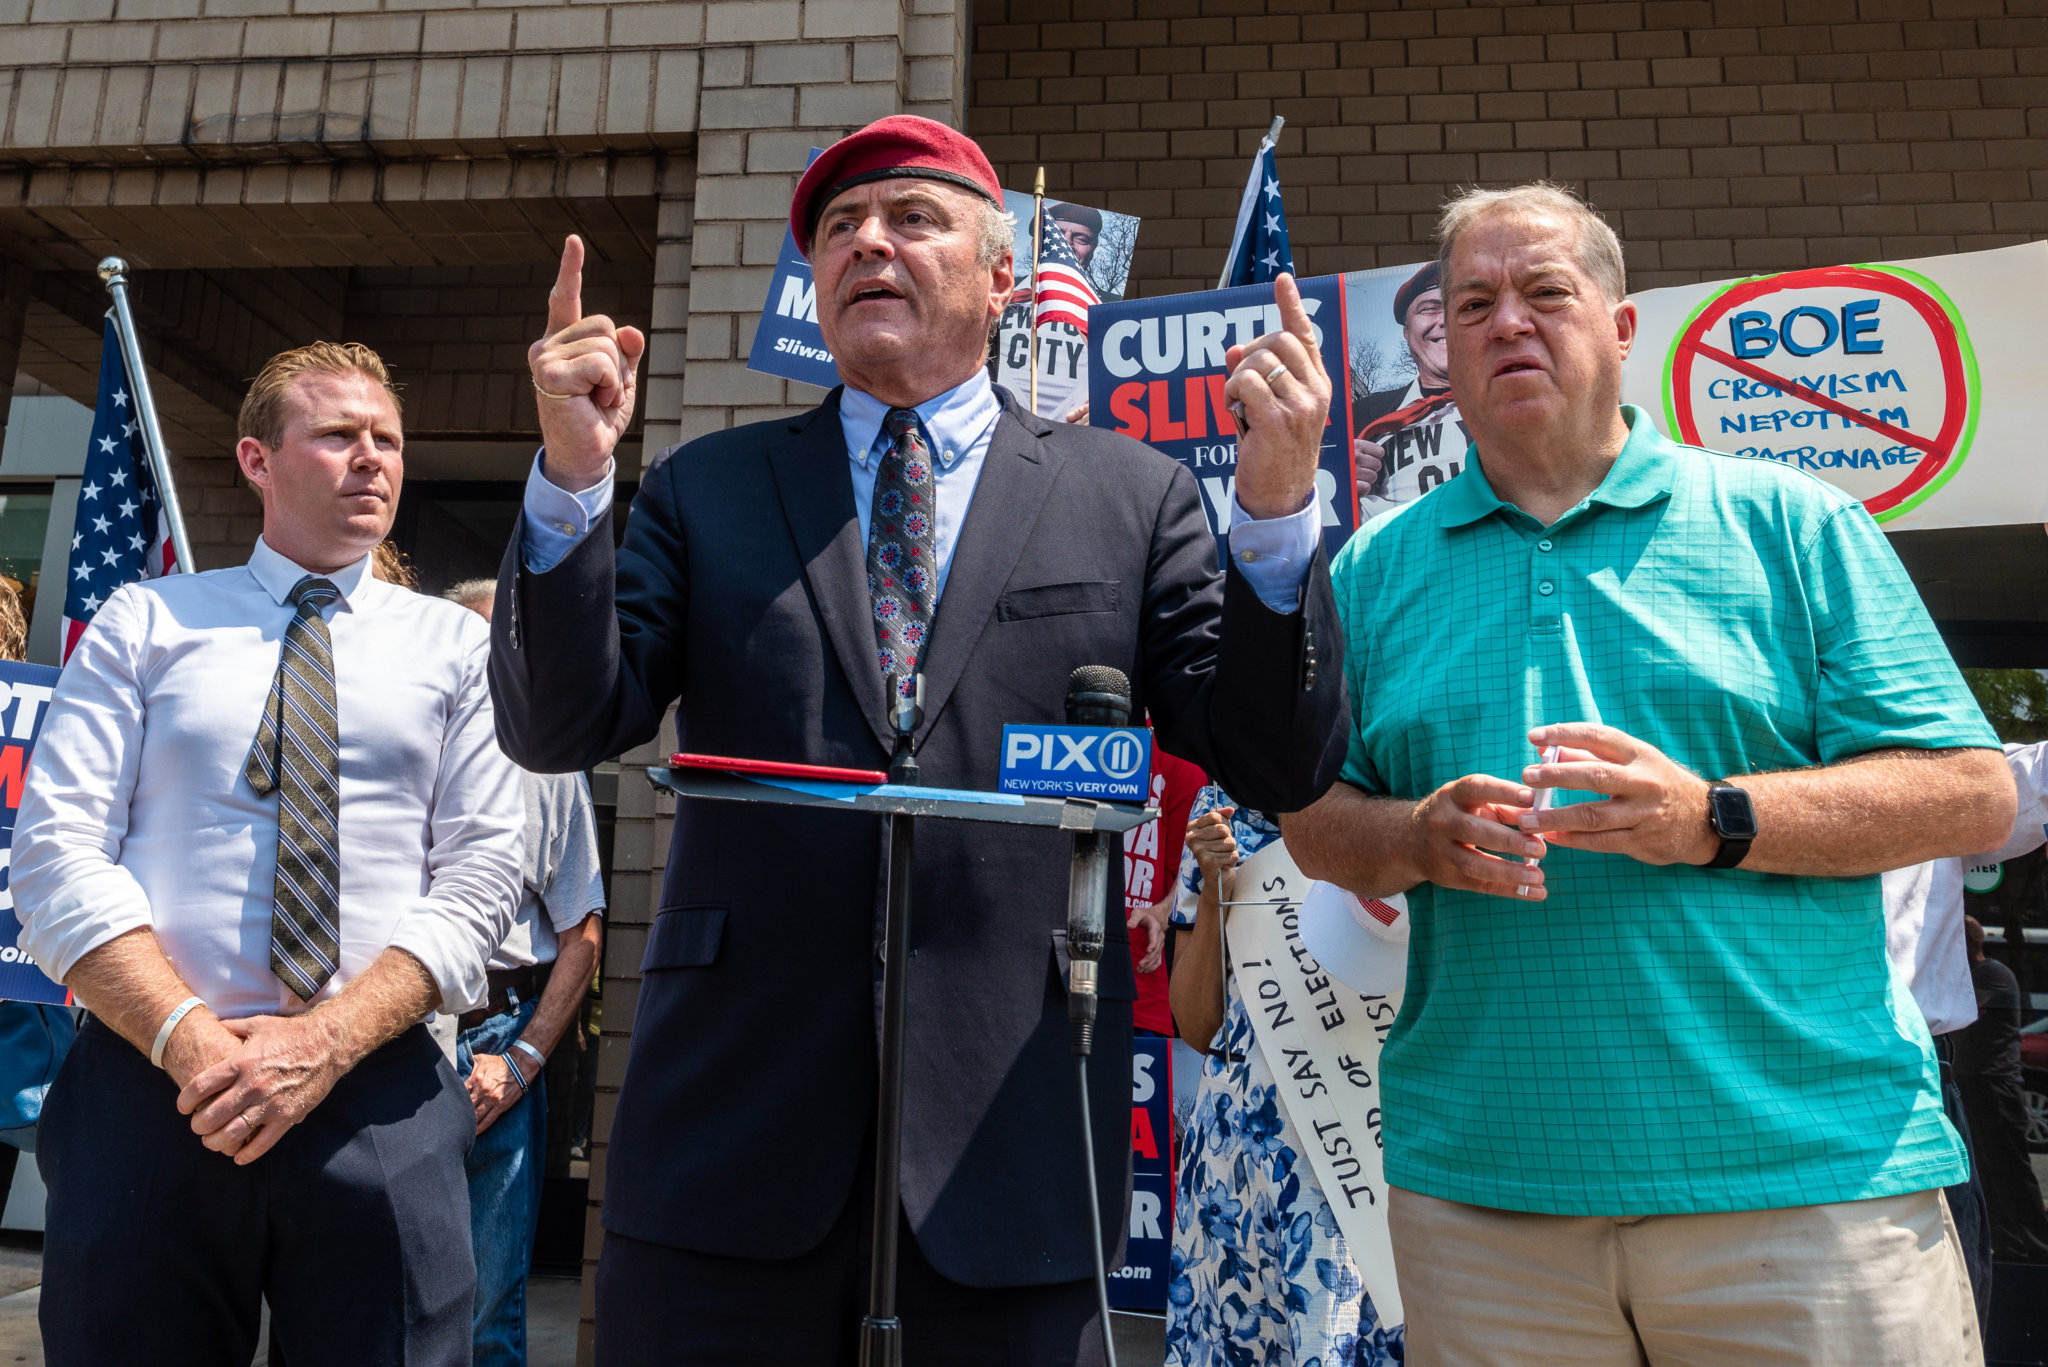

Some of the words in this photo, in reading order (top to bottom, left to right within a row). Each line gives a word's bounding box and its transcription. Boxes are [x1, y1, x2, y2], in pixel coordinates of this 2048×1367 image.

[1000, 305, 1032, 331] EW
[1729, 299, 1884, 360] BOE
[1708, 369, 1908, 402] CRONYISM
[1110, 374, 1332, 443] SLI
[1720, 406, 1911, 434] NEPOTISM
[1006, 733, 1099, 772] PIX
[1004, 779, 1030, 790] NEW
[1030, 780, 1074, 792] YORK'S
[1075, 782, 1107, 793] VERY
[1108, 783, 1139, 795] OWN
[1262, 876, 1346, 1032] ELECTIONS
[1242, 958, 1295, 1031] NO!
[1281, 1048, 1329, 1099] SAY
[1337, 1054, 1372, 1088] OF
[1313, 1119, 1376, 1209] JUST
